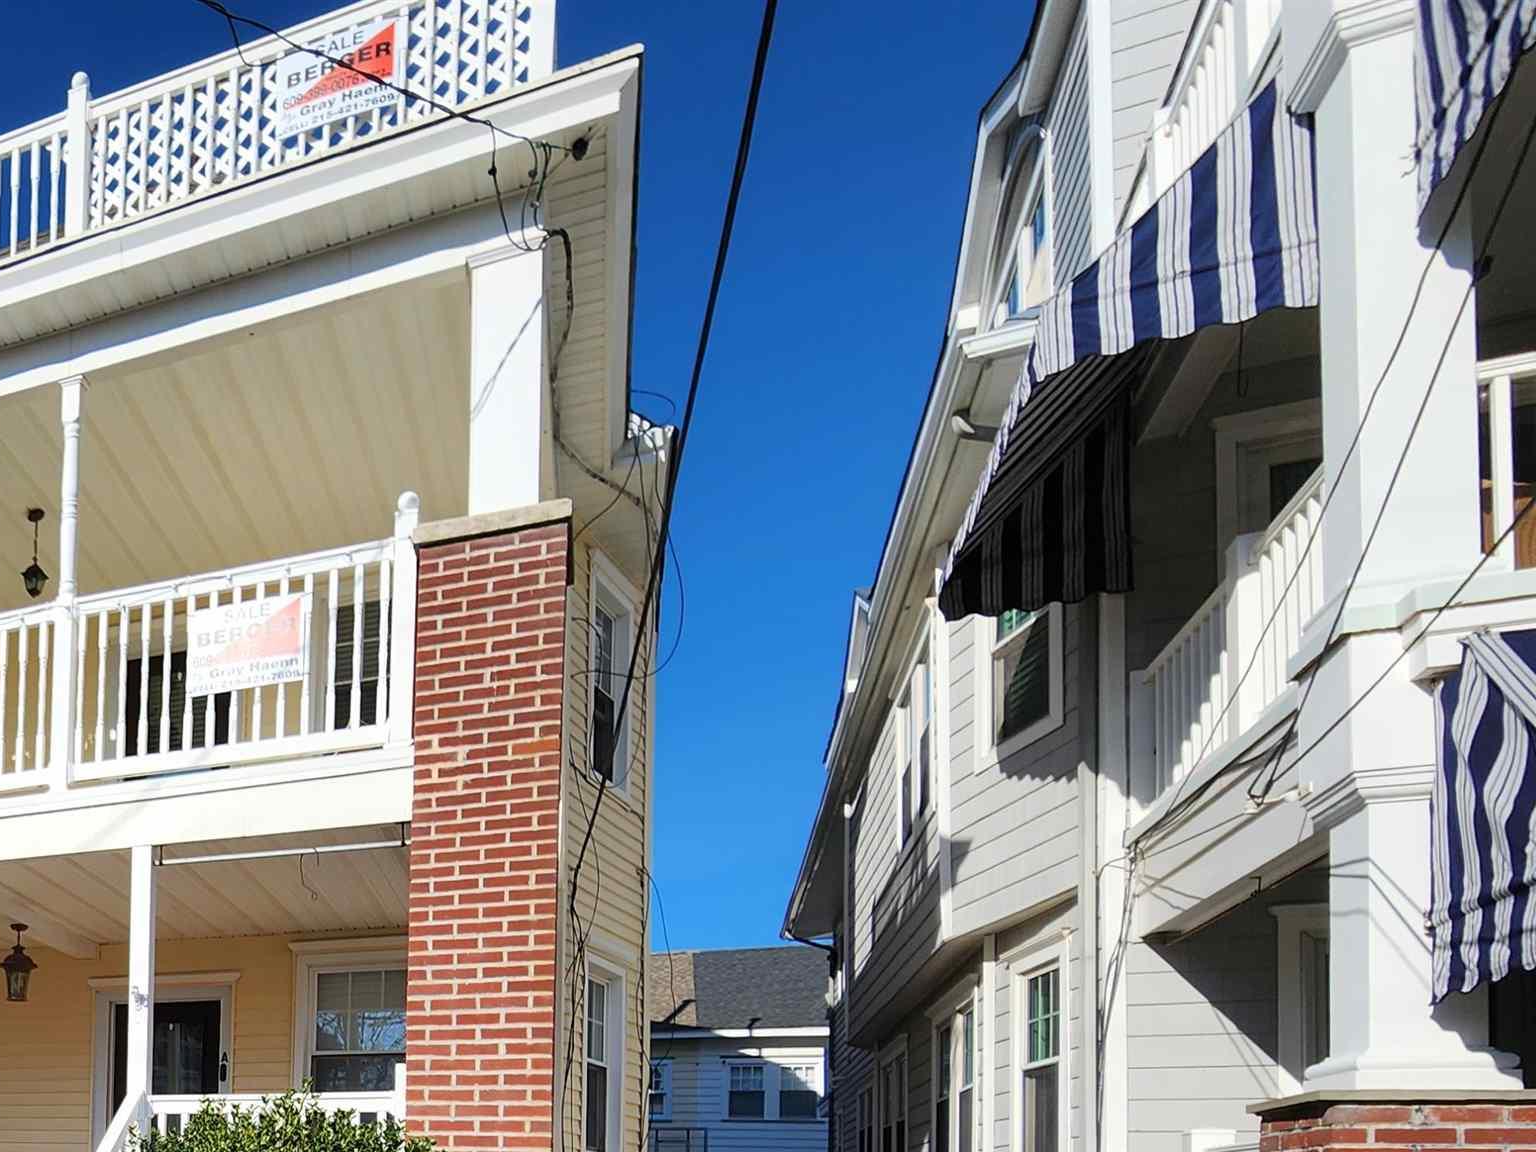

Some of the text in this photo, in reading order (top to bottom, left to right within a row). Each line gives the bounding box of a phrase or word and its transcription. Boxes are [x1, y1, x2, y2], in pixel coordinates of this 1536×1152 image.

[286, 41, 392, 89] BERGER
[299, 96, 336, 116] Gray
[224, 602, 271, 624] SALE
